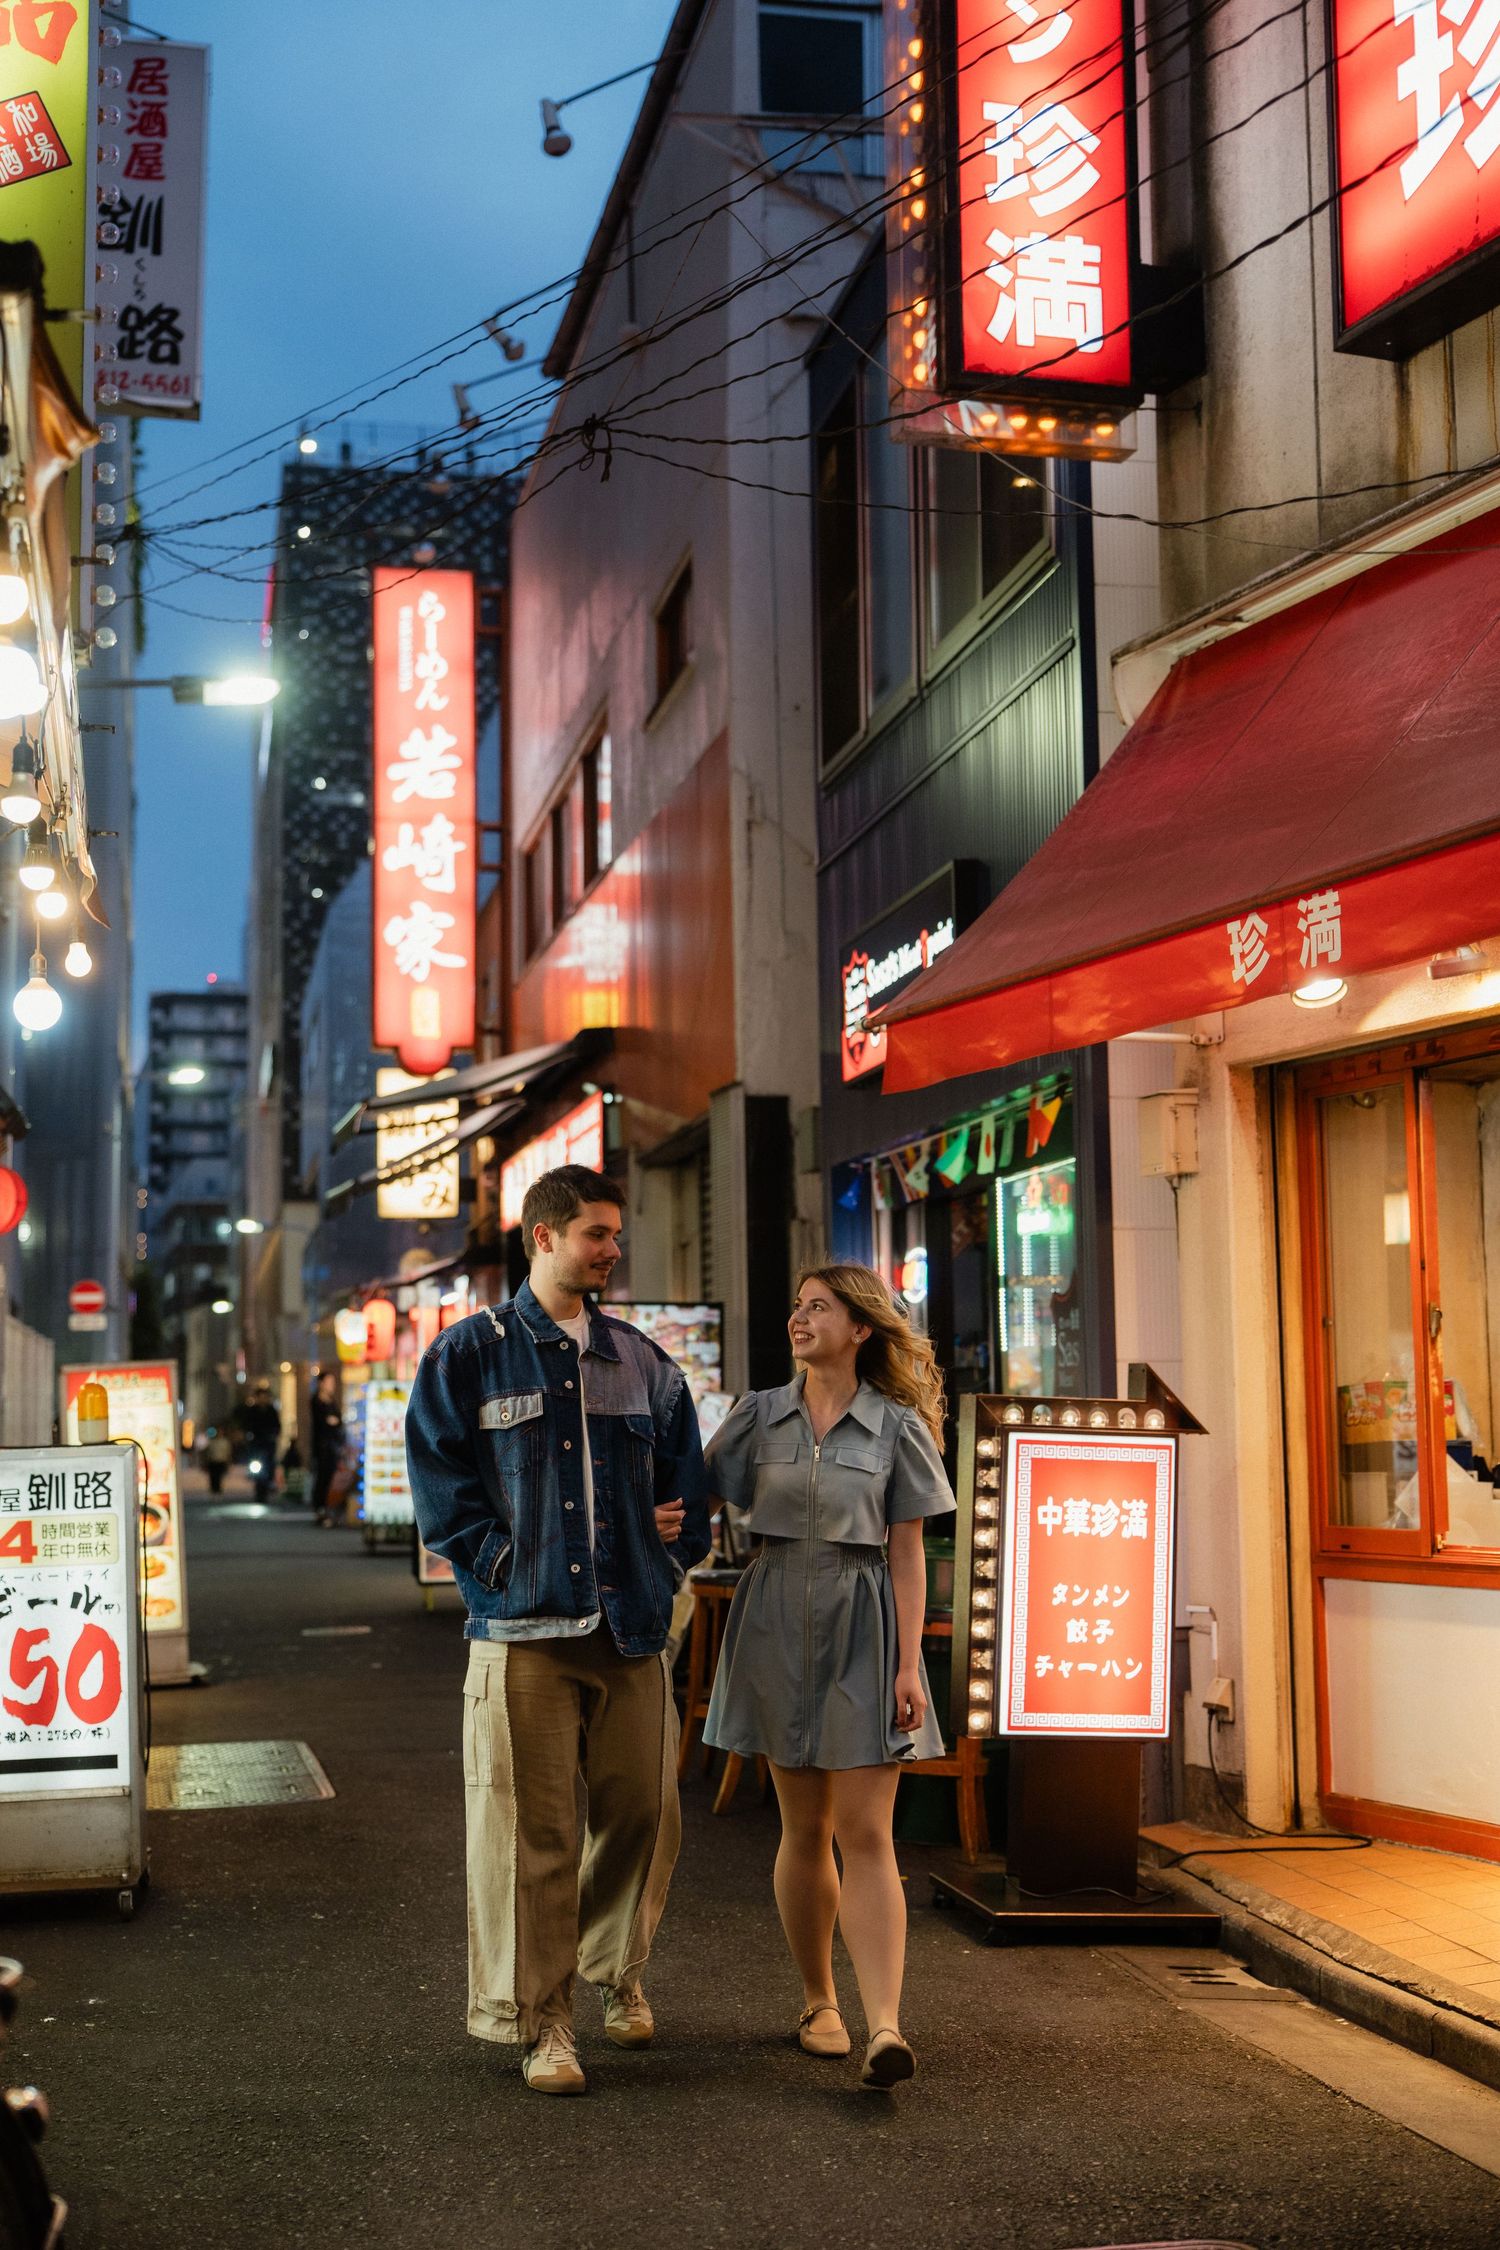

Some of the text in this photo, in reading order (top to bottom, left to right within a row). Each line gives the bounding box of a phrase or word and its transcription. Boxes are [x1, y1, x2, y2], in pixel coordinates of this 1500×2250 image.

[123, 57, 170, 181] 居酒屋
[414, 590, 450, 711] らーめん
[382, 723, 468, 984] 若崎家
[1226, 888, 1342, 987] 珍満
[41, 1522, 111, 1540] 時間営業
[1037, 1495, 1149, 1540] 中華珍満
[42, 1541, 112, 1559] 年中無休
[1051, 1582, 1130, 1608] タンメン
[1065, 1617, 1115, 1645] 餃子
[1034, 1654, 1143, 1681] チャーハン
